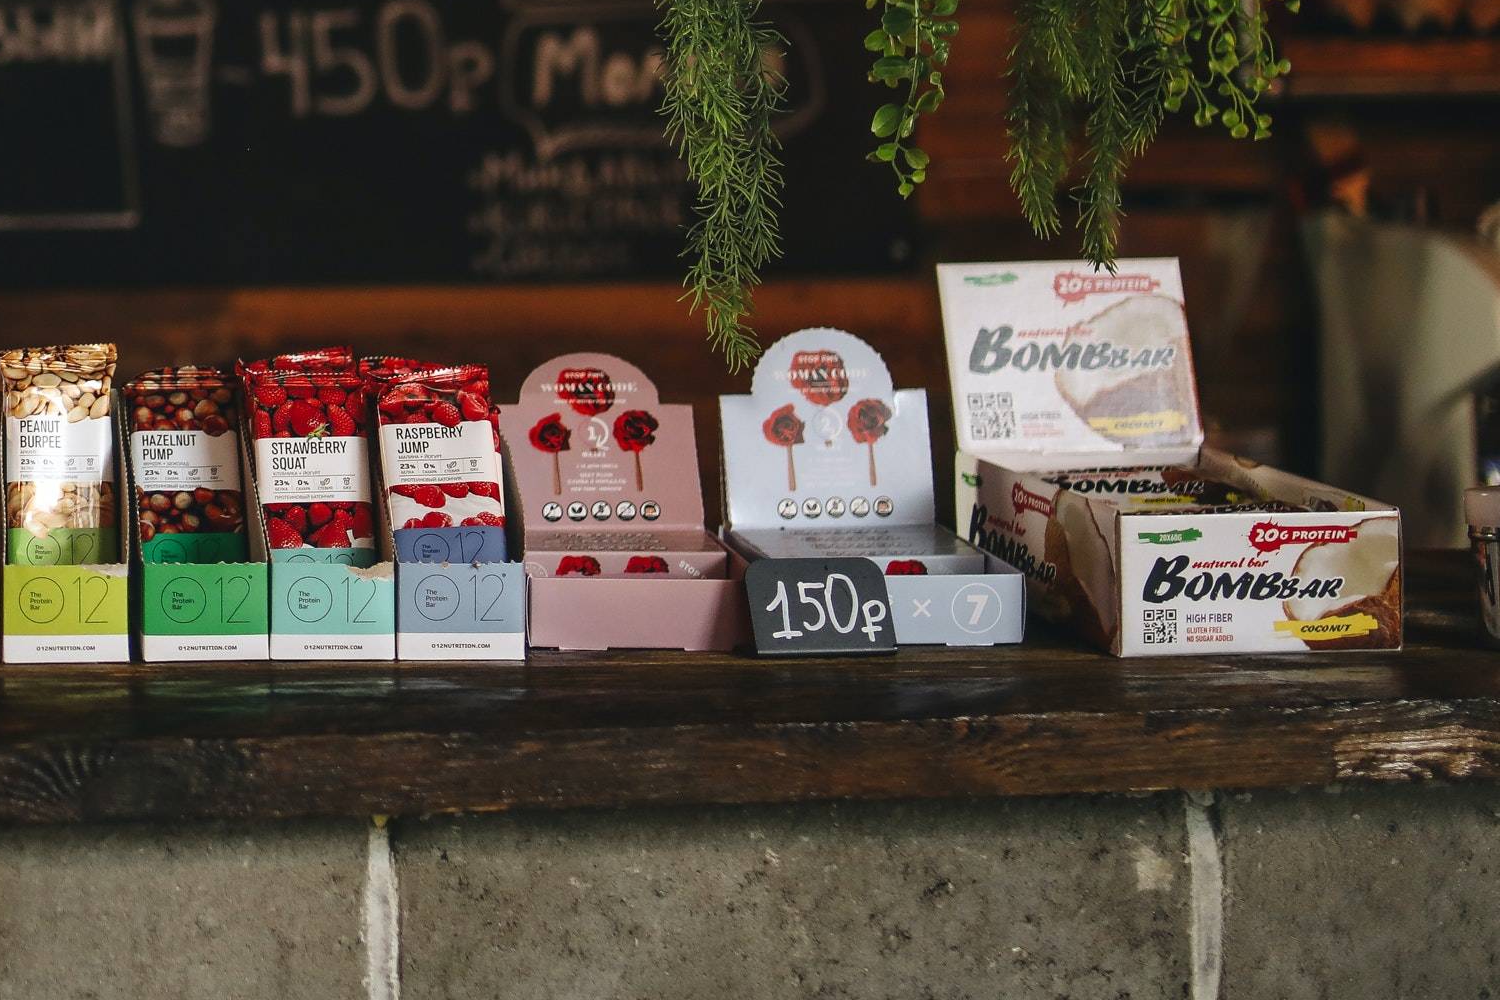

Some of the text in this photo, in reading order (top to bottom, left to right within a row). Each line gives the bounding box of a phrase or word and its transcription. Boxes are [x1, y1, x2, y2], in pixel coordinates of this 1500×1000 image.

[1095, 278, 1149, 290] PROTEIN
[20, 420, 60, 433] PEANUT
[396, 426, 463, 440] RASPBERRY
[20, 436, 62, 448] BURPEE
[142, 434, 196, 447] HAZELNUT
[271, 441, 347, 455] STRAWBERRY
[397, 441, 429, 454] JUMP
[143, 449, 173, 460] PUMP
[273, 457, 307, 470] SQUAT
[1028, 497, 1050, 513] PROTEIN
[1159, 533, 1182, 542] 20X60G
[1255, 529, 1346, 542] 20G PROTEIN
[1192, 558, 1268, 569] natural bar
[965, 594, 989, 625] 7
[1186, 613, 1233, 623] HIGH FIBER
[1300, 624, 1352, 633] COCONUT
